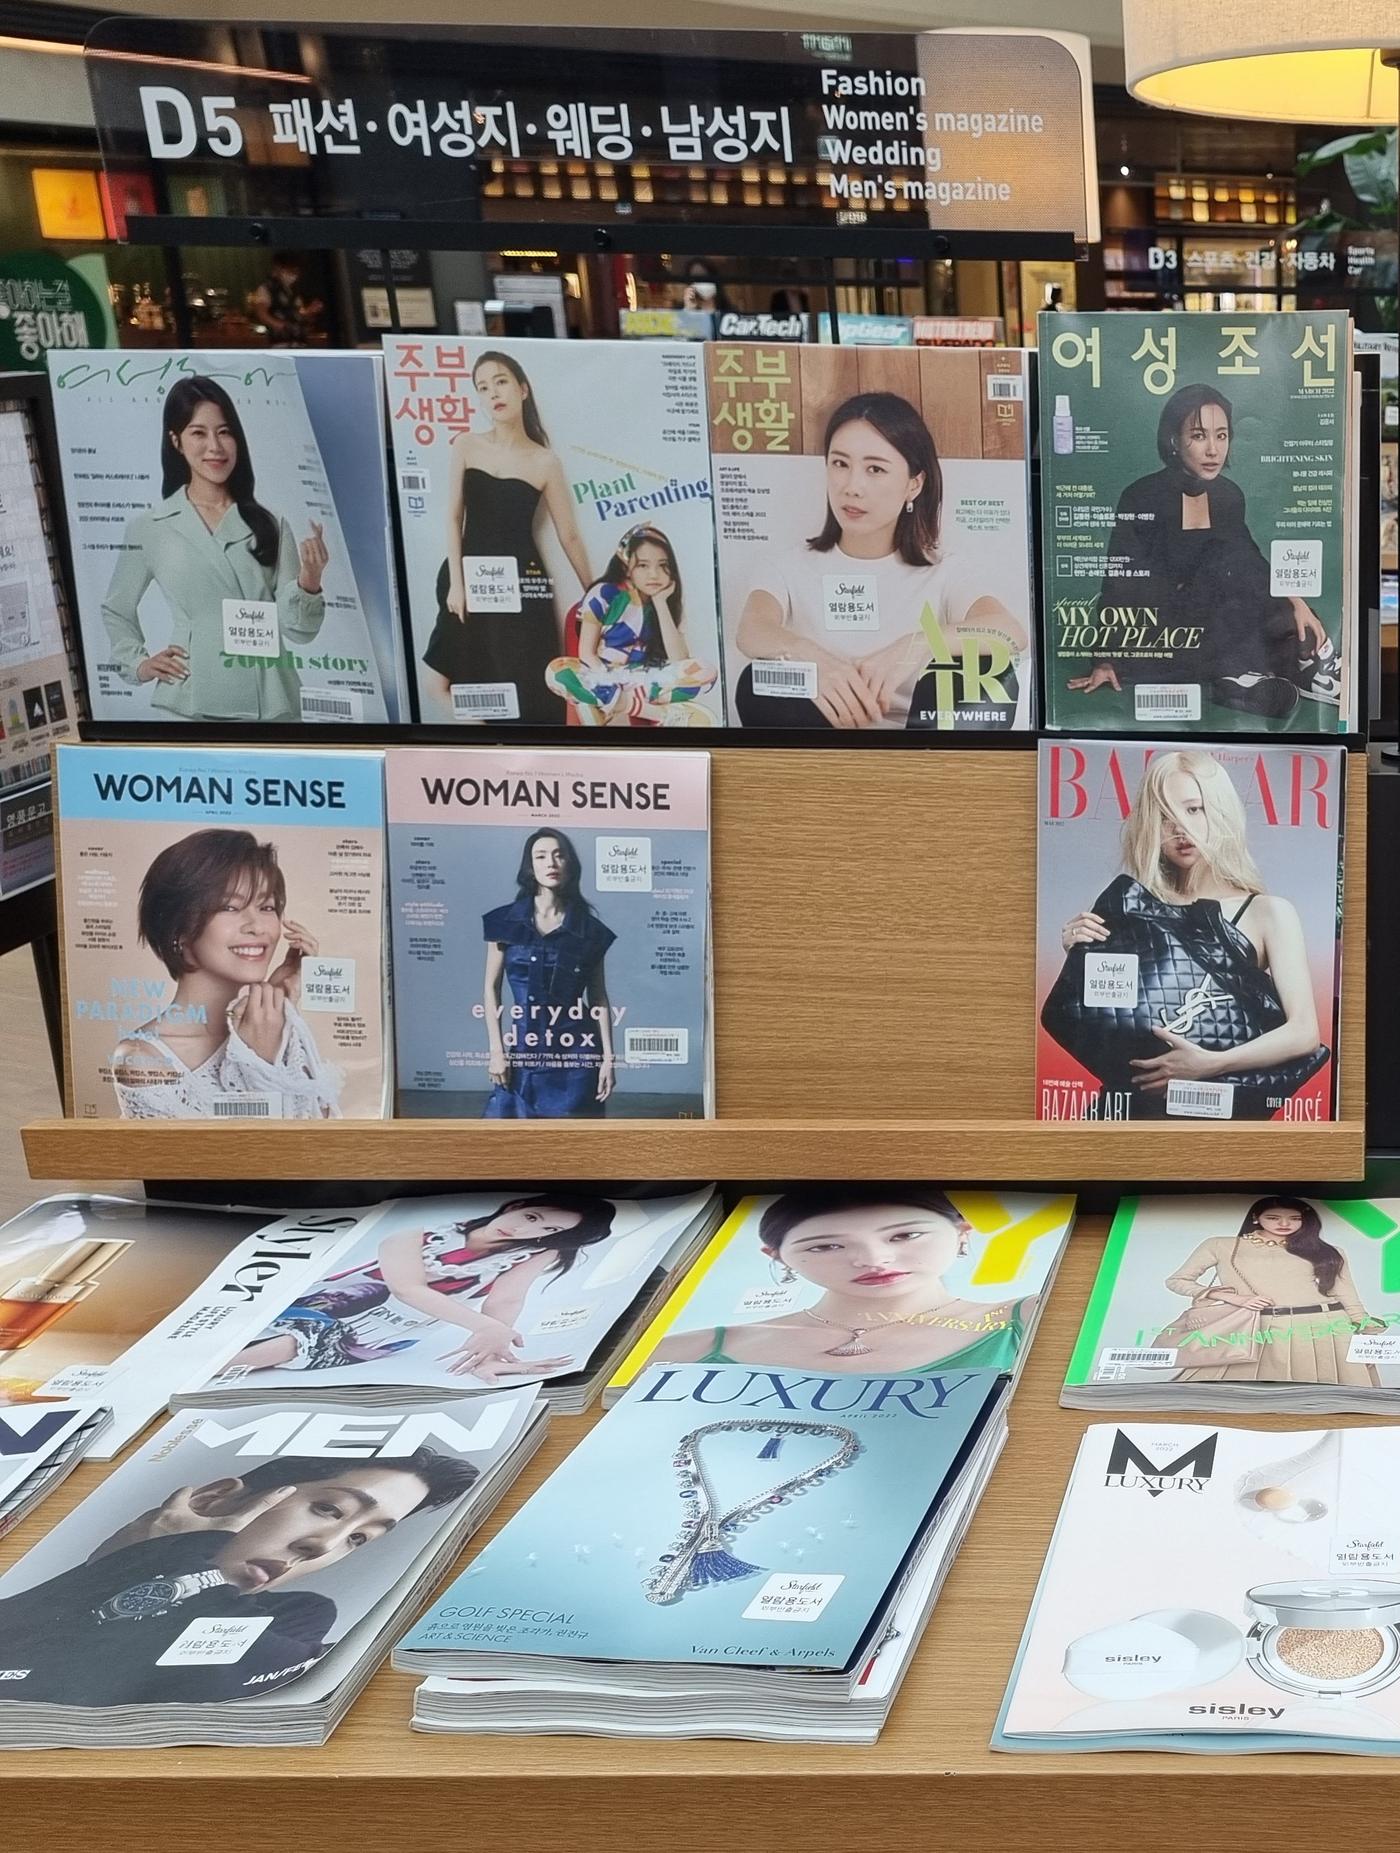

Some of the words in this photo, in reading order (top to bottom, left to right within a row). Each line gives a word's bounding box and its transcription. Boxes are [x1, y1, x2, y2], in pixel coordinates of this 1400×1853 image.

[821, 69, 926, 96] Fashion
[139, 85, 243, 160] D5
[822, 105, 928, 133] Women's
[934, 111, 1043, 139] magazine
[828, 138, 941, 169] Wedding
[830, 173, 897, 200] Men's
[902, 180, 1011, 205] magazine
[1148, 246, 1177, 270] D3
[11, 310, 90, 360] 좋아해
[394, 345, 471, 392] 주부
[713, 348, 791, 397] 주부
[396, 395, 475, 446] 생활
[713, 400, 796, 452] 생활
[572, 473, 636, 503] Plant
[595, 478, 711, 521] Parenting
[1057, 607, 1094, 626] MY
[1100, 607, 1159, 626] OWN
[1060, 625, 1117, 648] HOT
[1119, 626, 1204, 649] PLACE
[309, 649, 369, 674] story
[920, 709, 1007, 722] EVERYWHERE
[93, 773, 234, 806] WOMAN
[245, 778, 346, 809] SENSE
[421, 776, 560, 808] WOMAN
[571, 781, 671, 810] SENSE
[1044, 745, 1335, 829] BAAR
[601, 863, 647, 875] 열람용도서
[471, 998, 628, 1025] everyday
[503, 1024, 597, 1048] detox
[1042, 1088, 1099, 1121] BAZAAR
[1103, 1092, 1132, 1121] ART
[1284, 1092, 1323, 1122] ROSÉ
[637, 1369, 982, 1419] LUXURY
[149, 1417, 205, 1463] Noblesse
[192, 1399, 521, 1459] MEN
[1105, 1427, 1219, 1477] M
[1103, 1473, 1211, 1495] LUXURY
[439, 1606, 498, 1620] GOLF
[496, 1607, 577, 1625] SPECIAL
[418, 1632, 440, 1640] ART
[453, 1633, 513, 1644] SCIENCE
[689, 1645, 721, 1656] Van
[722, 1645, 768, 1657] Cleef
[785, 1646, 837, 1659] Arpels
[1105, 1653, 1162, 1666] sisley
[1187, 1702, 1285, 1720] sisley
